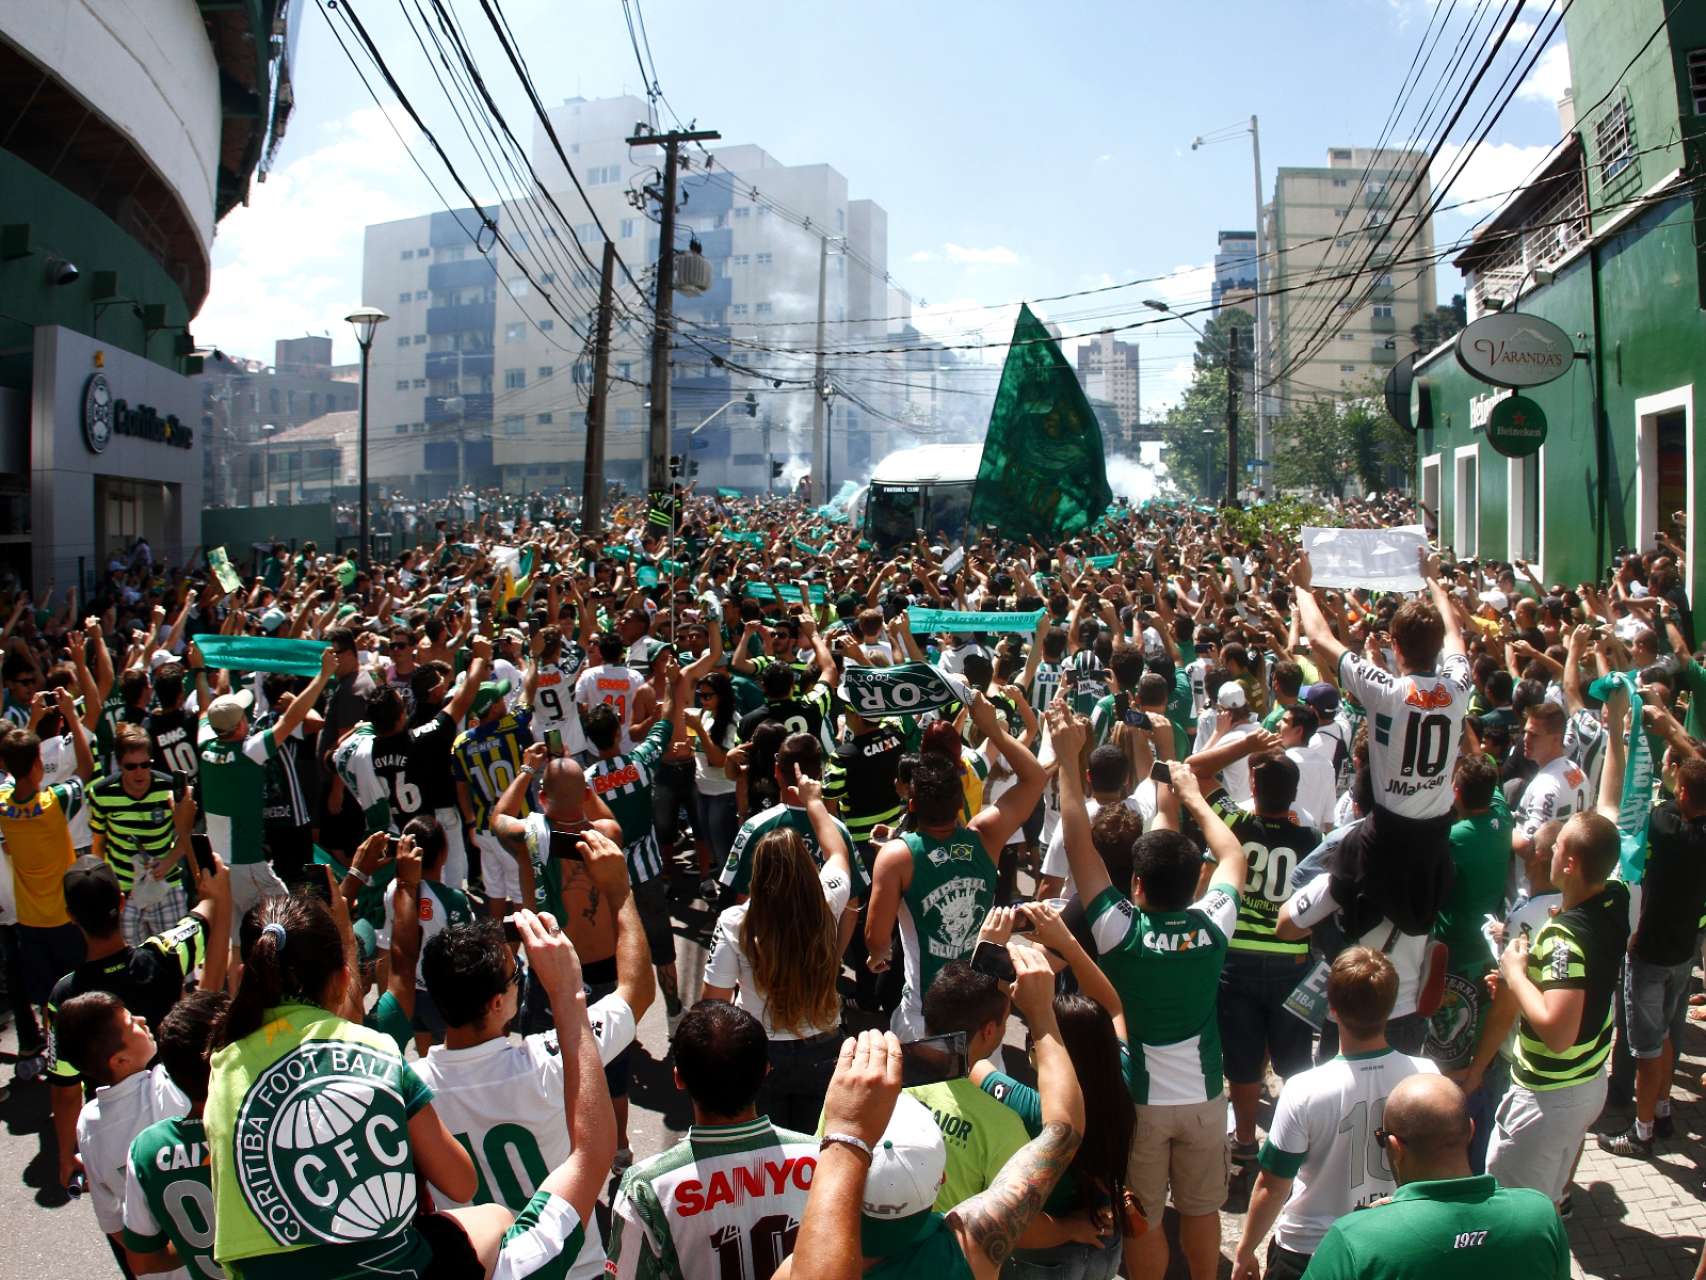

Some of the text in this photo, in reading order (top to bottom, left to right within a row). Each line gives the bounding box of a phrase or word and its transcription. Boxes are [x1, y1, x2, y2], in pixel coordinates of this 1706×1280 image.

[1474, 338, 1563, 366] VARANDA'S
[162, 742, 199, 778] 10
[864, 736, 900, 757] CAIXA
[1400, 710, 1451, 777] 10
[470, 760, 514, 802] 10
[592, 766, 640, 793] BMG
[1143, 929, 1212, 951] CAIXA
[243, 1116, 300, 1241] CORITIBA
[294, 1114, 408, 1207] CFC
[453, 1122, 551, 1214] 10
[675, 1157, 817, 1217] SANYO
[1453, 1230, 1488, 1249] 1977
